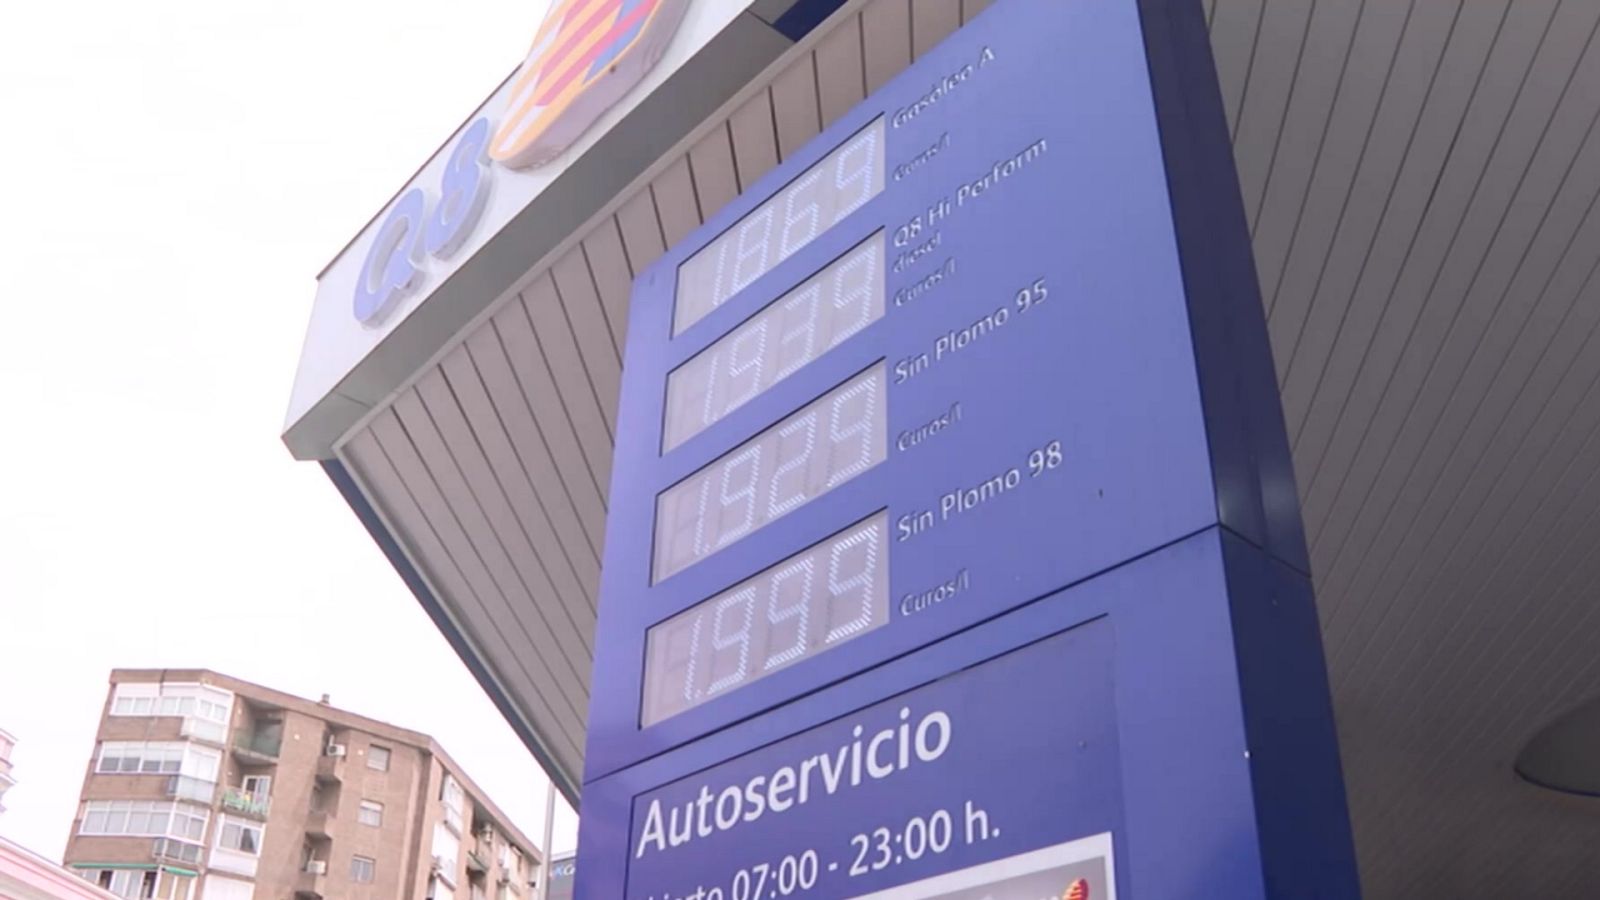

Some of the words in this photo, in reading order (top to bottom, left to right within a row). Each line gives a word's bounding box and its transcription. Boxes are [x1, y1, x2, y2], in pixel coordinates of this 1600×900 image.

[979, 46, 996, 68] A
[353, 117, 489, 325] Q8
[892, 215, 922, 248] Q8
[928, 196, 951, 226] Hi
[956, 138, 1048, 206] Perform
[894, 354, 929, 385] Sin
[935, 306, 1009, 361] Plomo
[1015, 279, 1048, 314] 95
[897, 508, 934, 542] Sin
[940, 467, 1020, 521] Plomo
[1028, 440, 1063, 478] 98
[636, 706, 952, 859] Autoservicio
[732, 849, 819, 900] 07:00
[849, 809, 952, 877] 23:00
[965, 801, 1001, 845] h.
